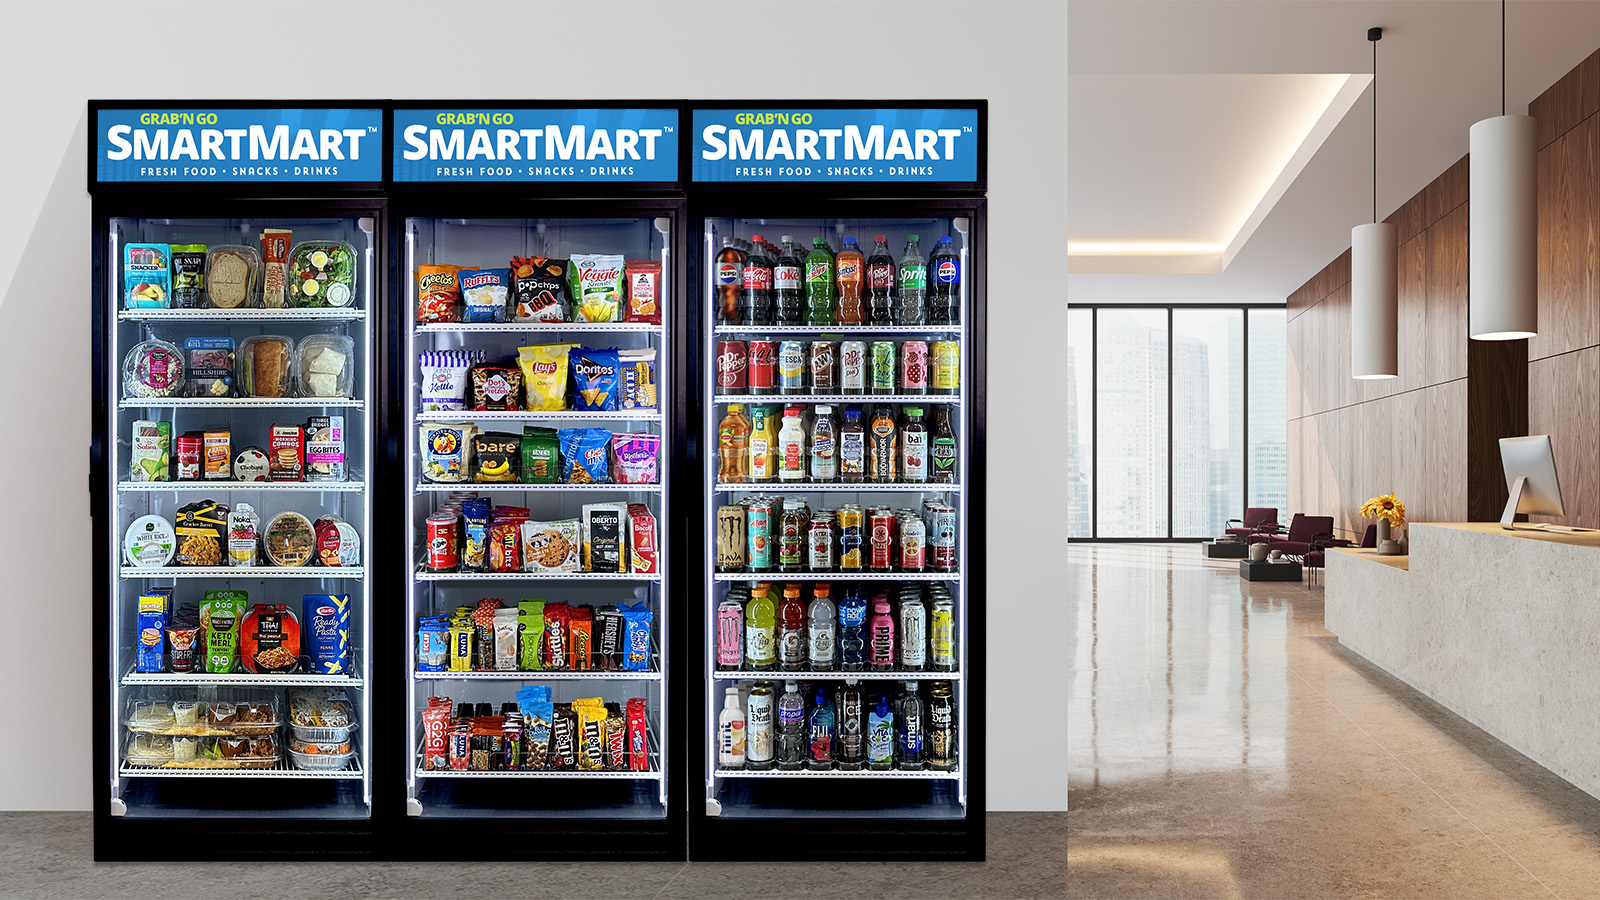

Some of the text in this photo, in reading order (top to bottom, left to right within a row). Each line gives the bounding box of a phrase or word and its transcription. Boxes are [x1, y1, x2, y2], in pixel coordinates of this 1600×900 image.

[196, 113, 218, 125] GO
[492, 113, 514, 125] GO
[791, 113, 812, 125] GO
[140, 167, 338, 175] FRESH FOOD SNACKS DRINKS
[436, 167, 635, 176] FRESH FOOD SNACKS DRINKS
[736, 167, 934, 176] FRESH FOOD SNACKS DRINKS
[579, 268, 620, 282] Veggie
[775, 268, 799, 280] Coke
[420, 272, 455, 291] Cheetos
[464, 276, 500, 288] RUFFLES
[518, 281, 559, 292] popchips
[528, 291, 557, 313] BBQ
[534, 362, 556, 374] Lay's
[575, 364, 613, 375] Doritos
[718, 355, 745, 372] Pepper
[430, 383, 454, 393] Kettle
[908, 435, 922, 443] bai
[476, 440, 515, 452] bare
[504, 534, 515, 549] RITZ
[720, 552, 742, 561] JAVA
[313, 616, 340, 629] Ready
[316, 626, 337, 636] Pasta
[604, 617, 618, 656] HERSHEY'S
[550, 621, 564, 667] Skittles
[580, 630, 589, 660] Reese's
[875, 627, 890, 661] PRIME
[432, 721, 443, 747] G2G
[813, 726, 828, 737] FIJI
[907, 715, 916, 749] smart
